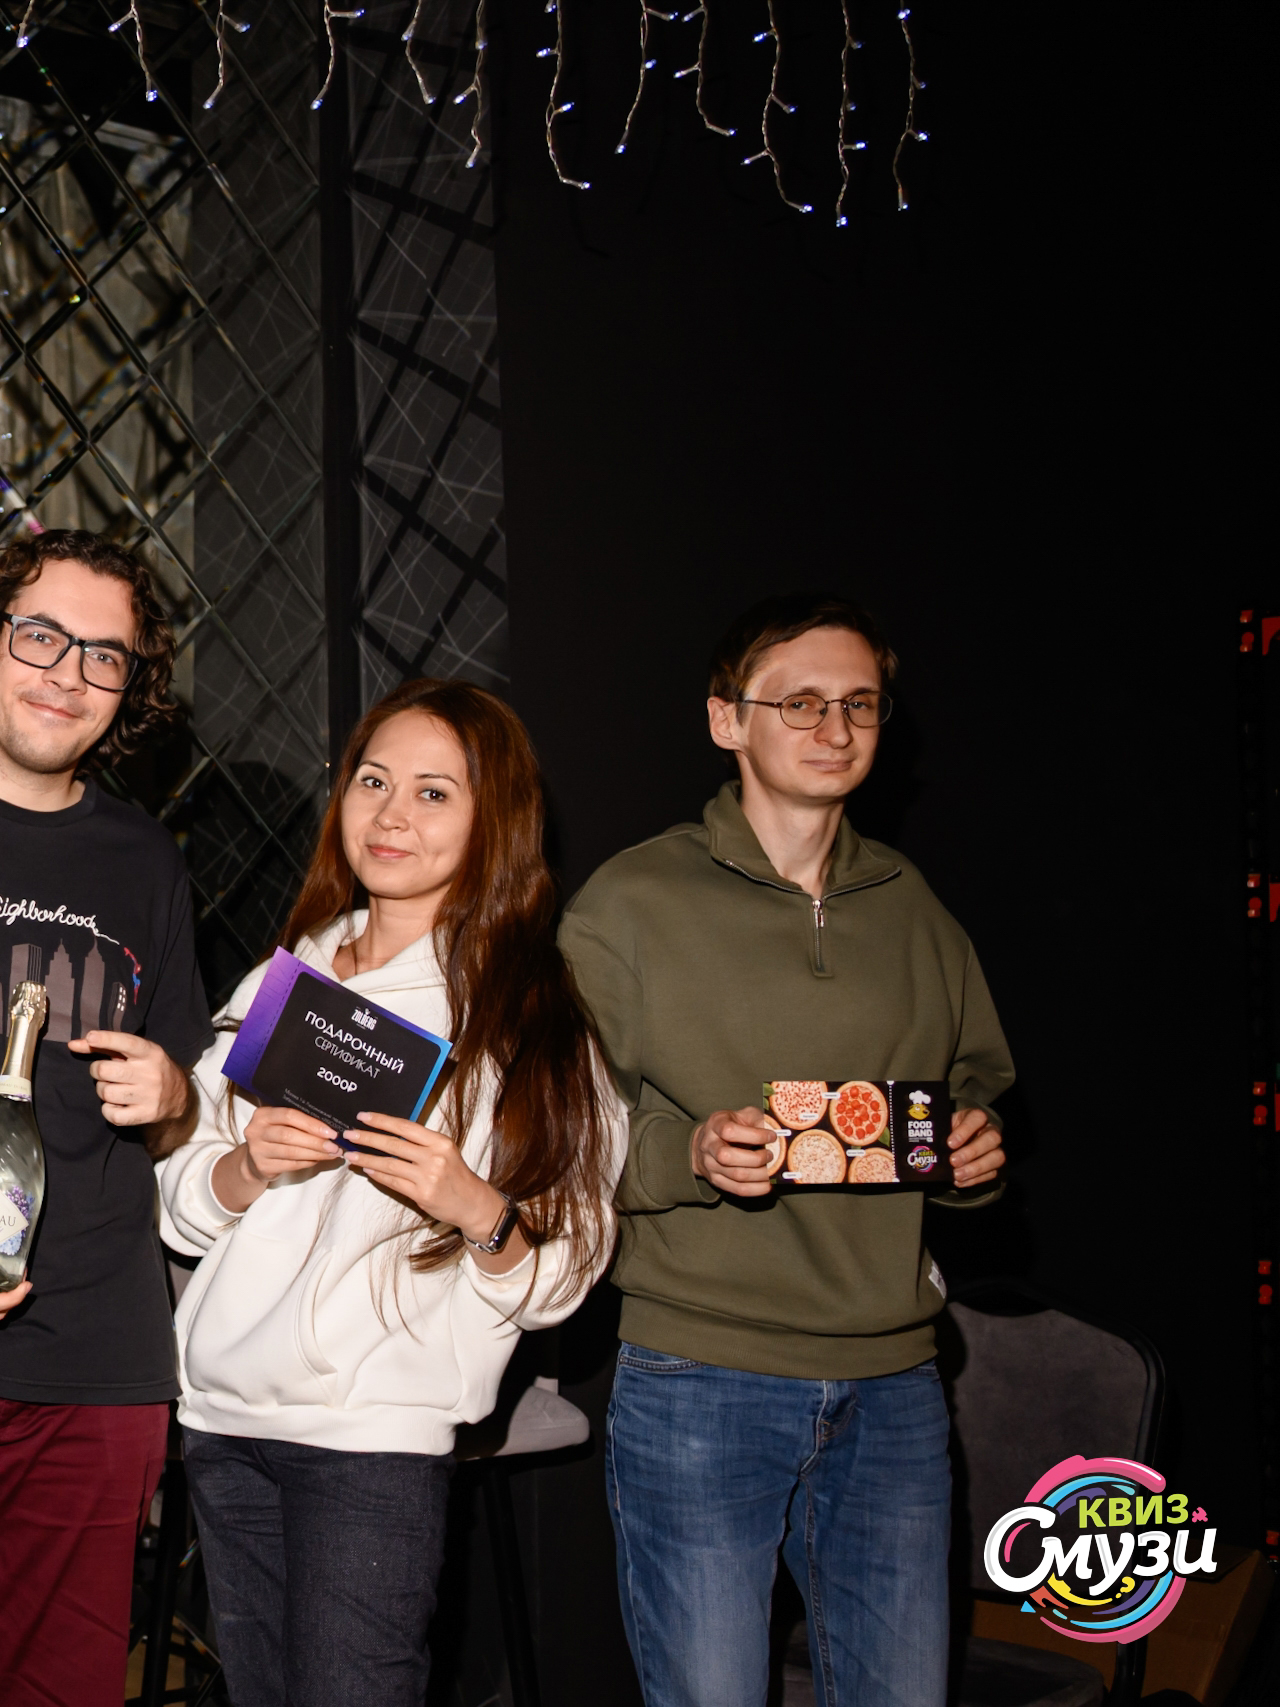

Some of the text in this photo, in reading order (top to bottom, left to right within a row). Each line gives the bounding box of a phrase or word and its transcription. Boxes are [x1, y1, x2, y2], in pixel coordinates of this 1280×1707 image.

[304, 1010, 405, 1075] ПОДАРОЧНЫЙ
[314, 1036, 381, 1079] СЕРТИФИКАТ
[907, 1120, 933, 1129] FOOD
[907, 1128, 934, 1138] BAND
[907, 1152, 937, 1166] Смузи
